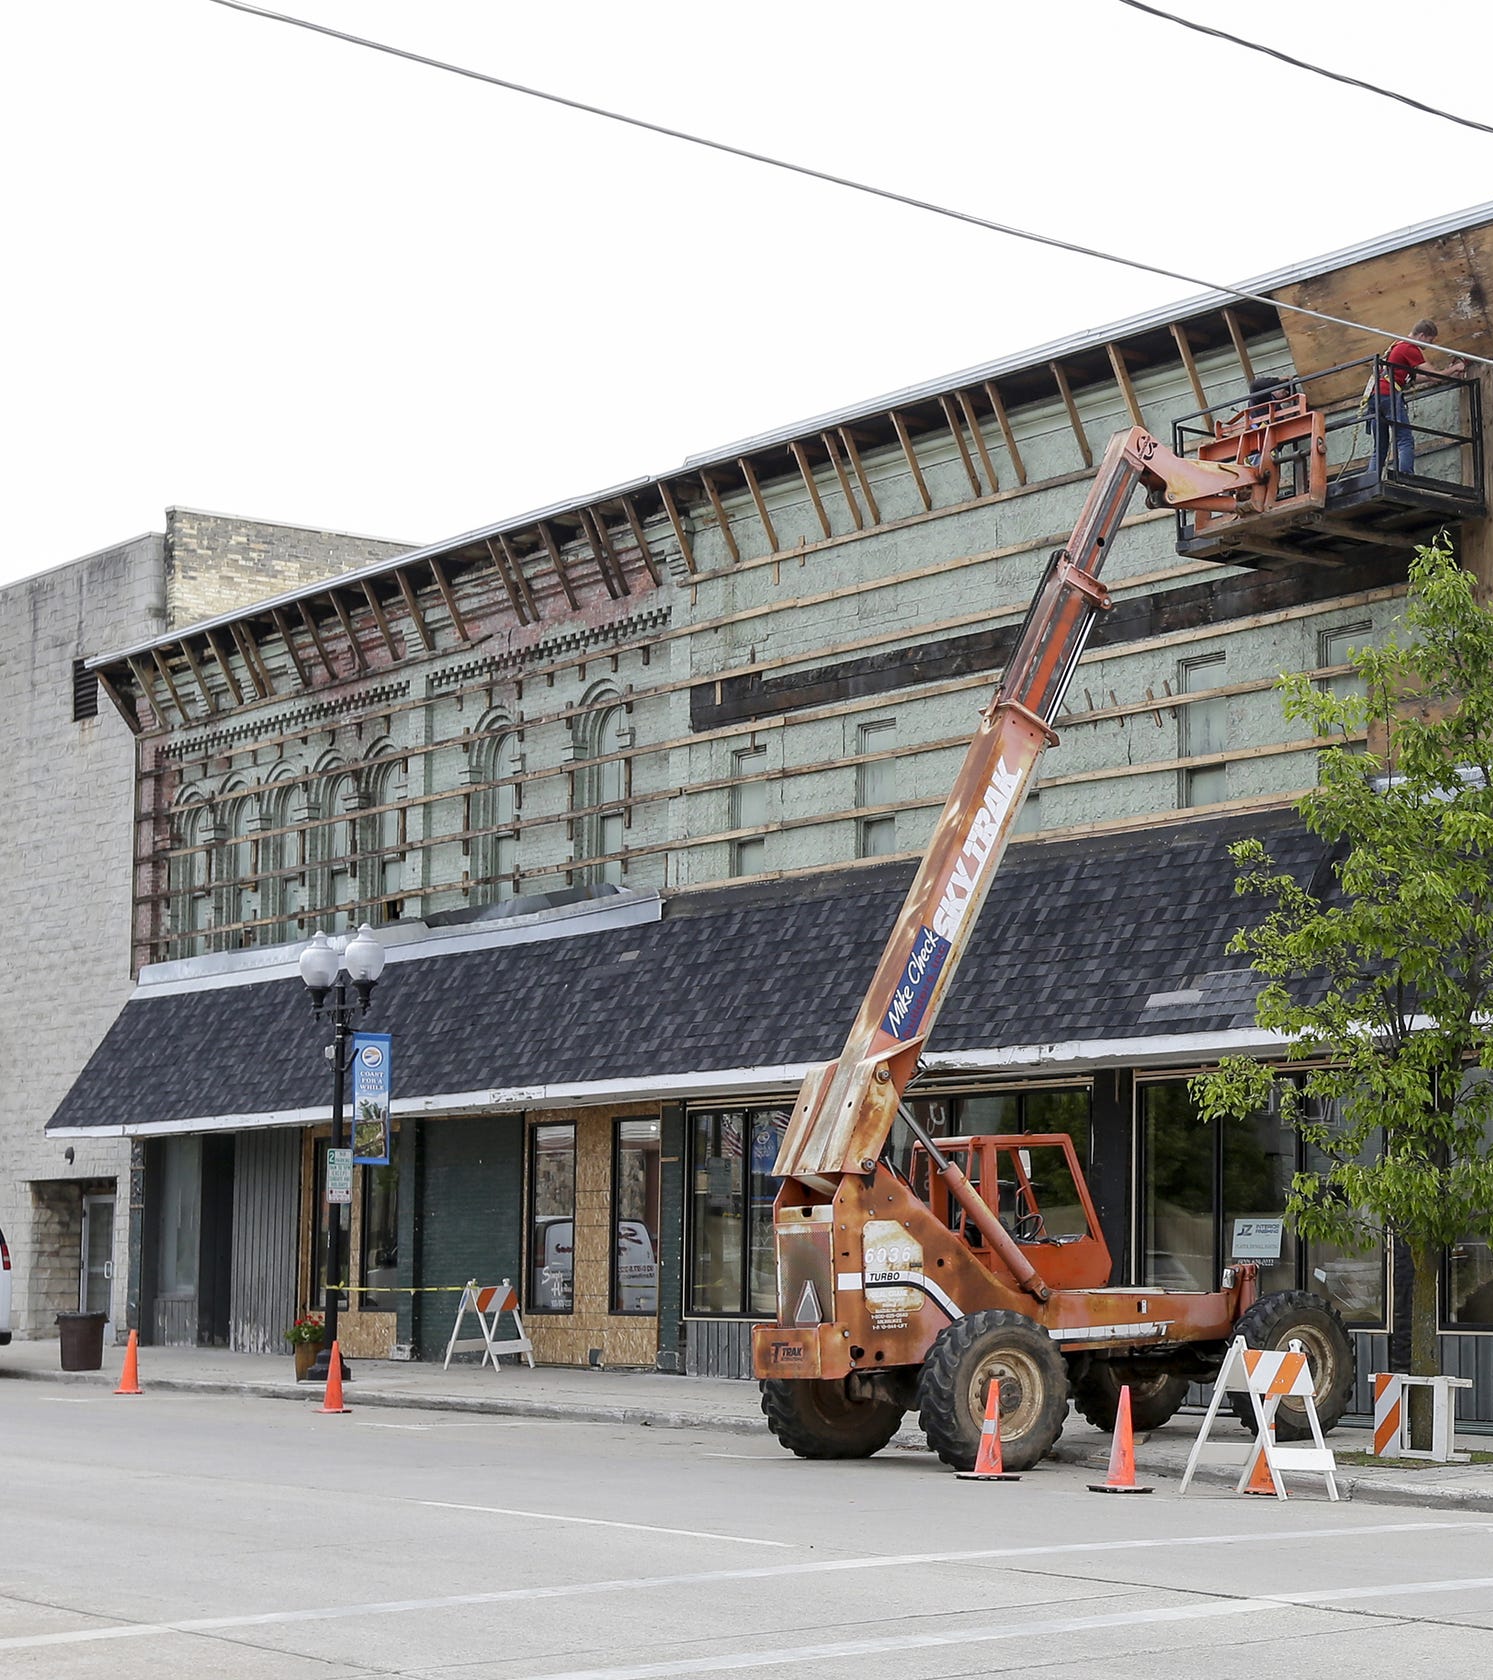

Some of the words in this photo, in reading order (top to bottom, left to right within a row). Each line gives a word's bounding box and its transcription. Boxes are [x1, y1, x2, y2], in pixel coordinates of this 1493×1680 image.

[888, 986, 914, 1038] Mike
[908, 928, 939, 984] Check
[330, 1151, 335, 1163] 2
[1237, 1224, 1253, 1236] JZ
[865, 1246, 911, 1263] 6036
[869, 1272, 900, 1281] TURBO
